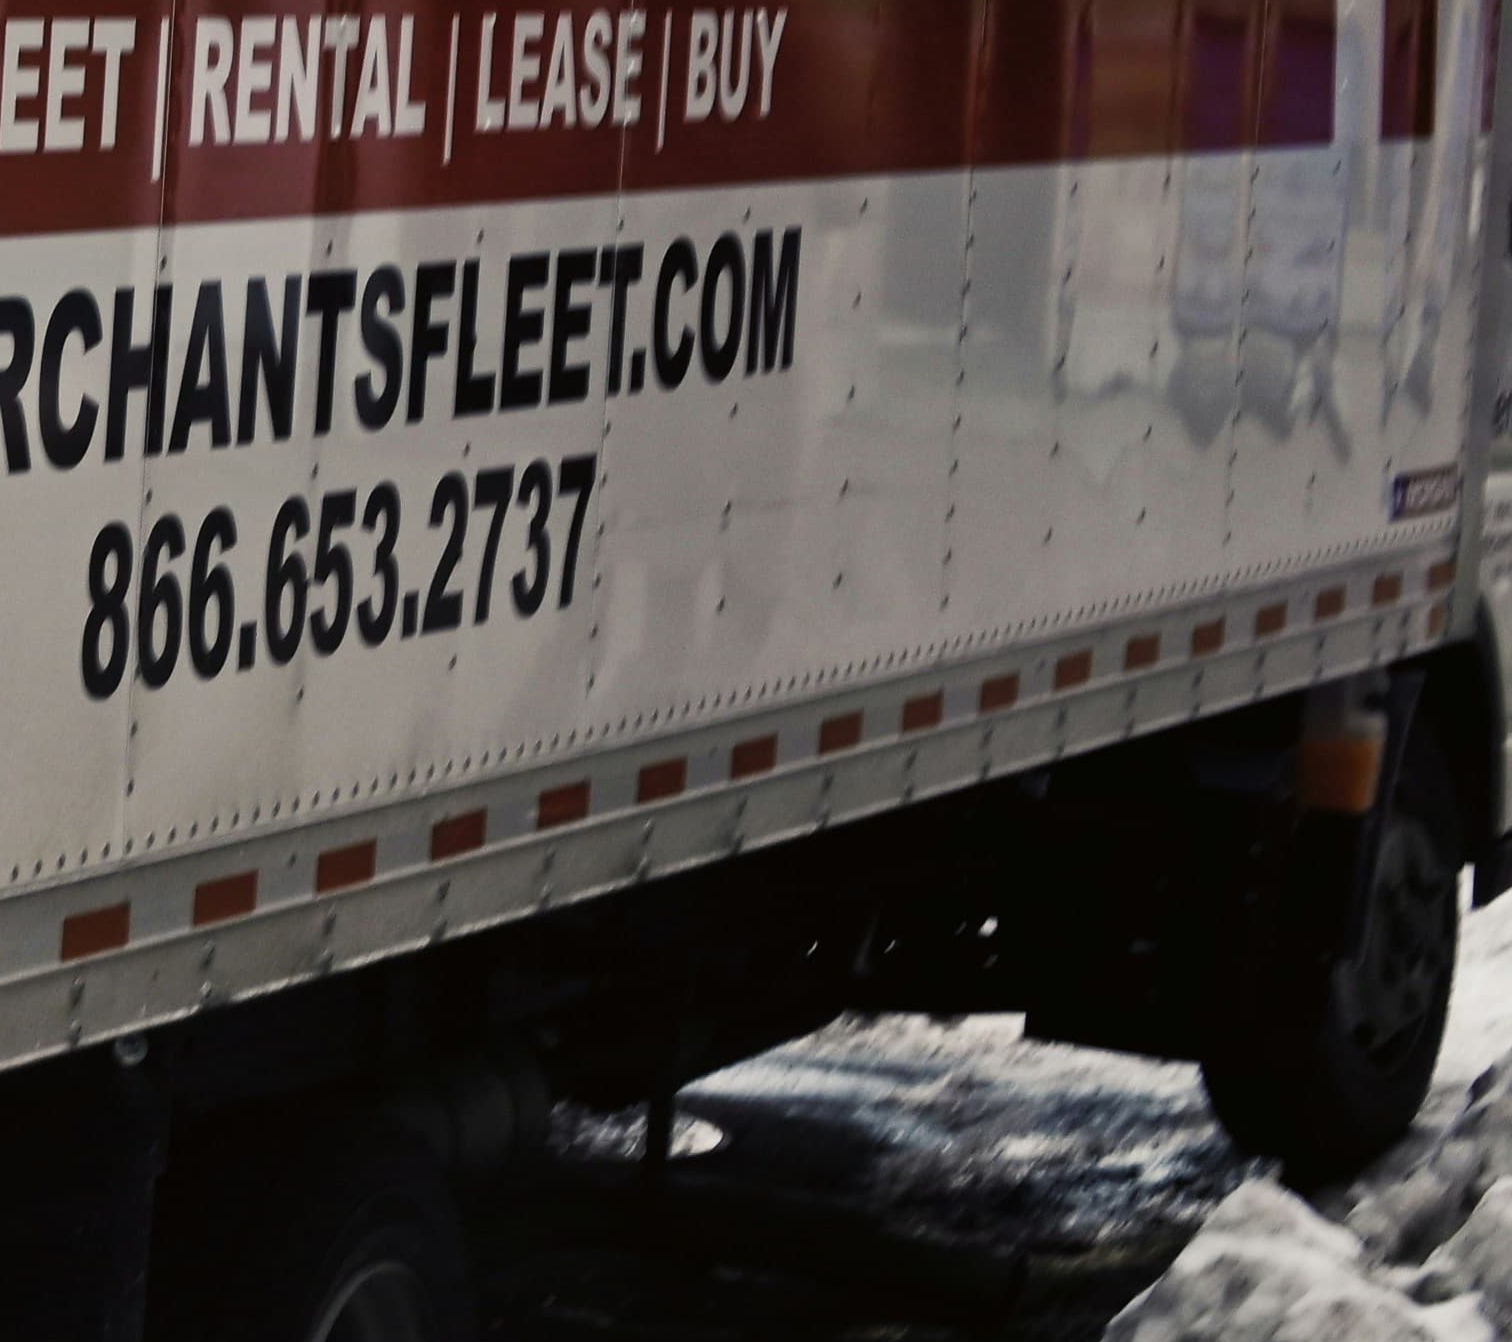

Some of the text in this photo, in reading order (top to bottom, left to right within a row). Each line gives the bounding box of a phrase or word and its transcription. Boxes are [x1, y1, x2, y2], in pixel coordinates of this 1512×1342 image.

[189, 13, 426, 147] RENTAL
[474, 8, 648, 133] LEASE
[683, 6, 789, 123] BUY
[80, 452, 598, 702] 866.653.2737
